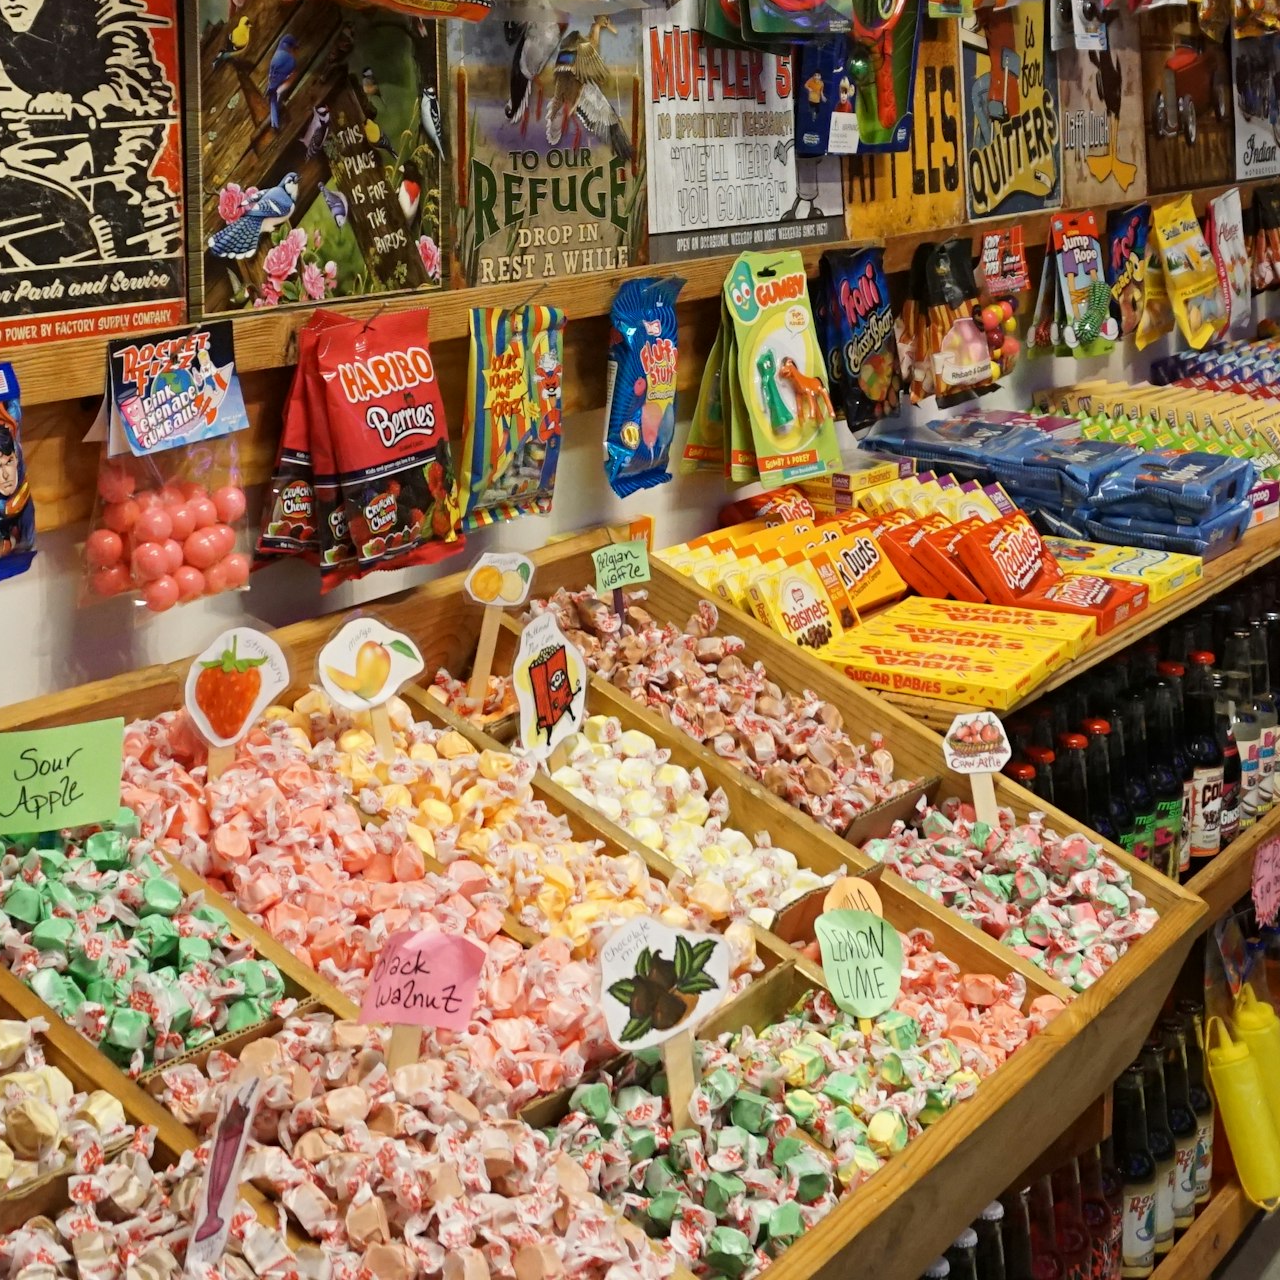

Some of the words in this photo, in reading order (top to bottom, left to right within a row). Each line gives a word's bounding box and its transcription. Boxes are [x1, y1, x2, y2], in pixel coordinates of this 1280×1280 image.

[509, 151, 537, 171] TO
[546, 147, 592, 169] OUR
[969, 86, 1059, 202] QUITTERS
[471, 153, 630, 251] REFUGE
[480, 254, 536, 284] REST
[542, 253, 557, 276] A
[561, 244, 629, 272] WHILE
[14, 274, 65, 304] Parts
[69, 272, 107, 297] and
[110, 267, 170, 293] Service
[339, 348, 436, 405] HARIBO
[366, 402, 436, 448] Berries
[596, 549, 640, 572] Belgian
[781, 600, 830, 634] Raisinets
[843, 665, 891, 689] SUGAR
[892, 672, 942, 695] BABIES
[18, 746, 84, 785] Sour
[9, 777, 85, 820] Apple
[831, 922, 887, 963] LEMON
[837, 964, 887, 1001] LIME
